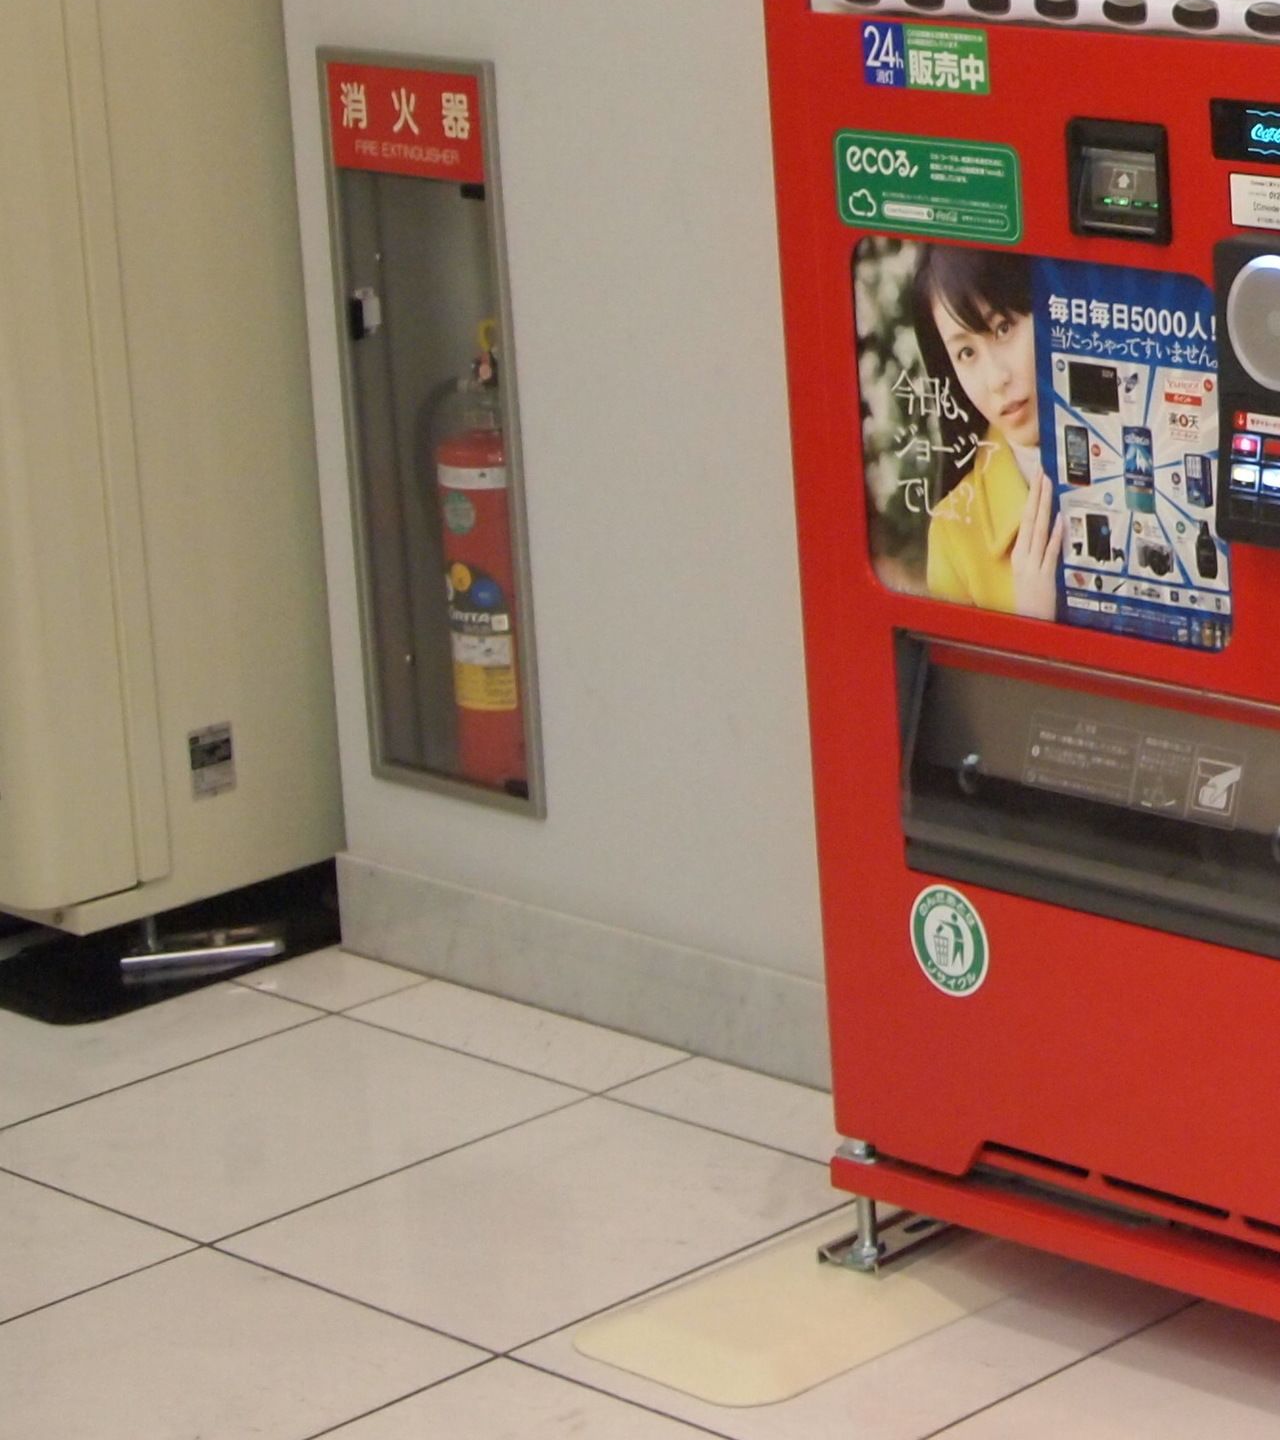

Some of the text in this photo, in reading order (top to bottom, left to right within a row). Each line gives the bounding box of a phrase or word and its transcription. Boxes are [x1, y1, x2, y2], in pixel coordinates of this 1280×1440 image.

[908, 50, 986, 90] 販売中
[341, 82, 470, 139] 消火器
